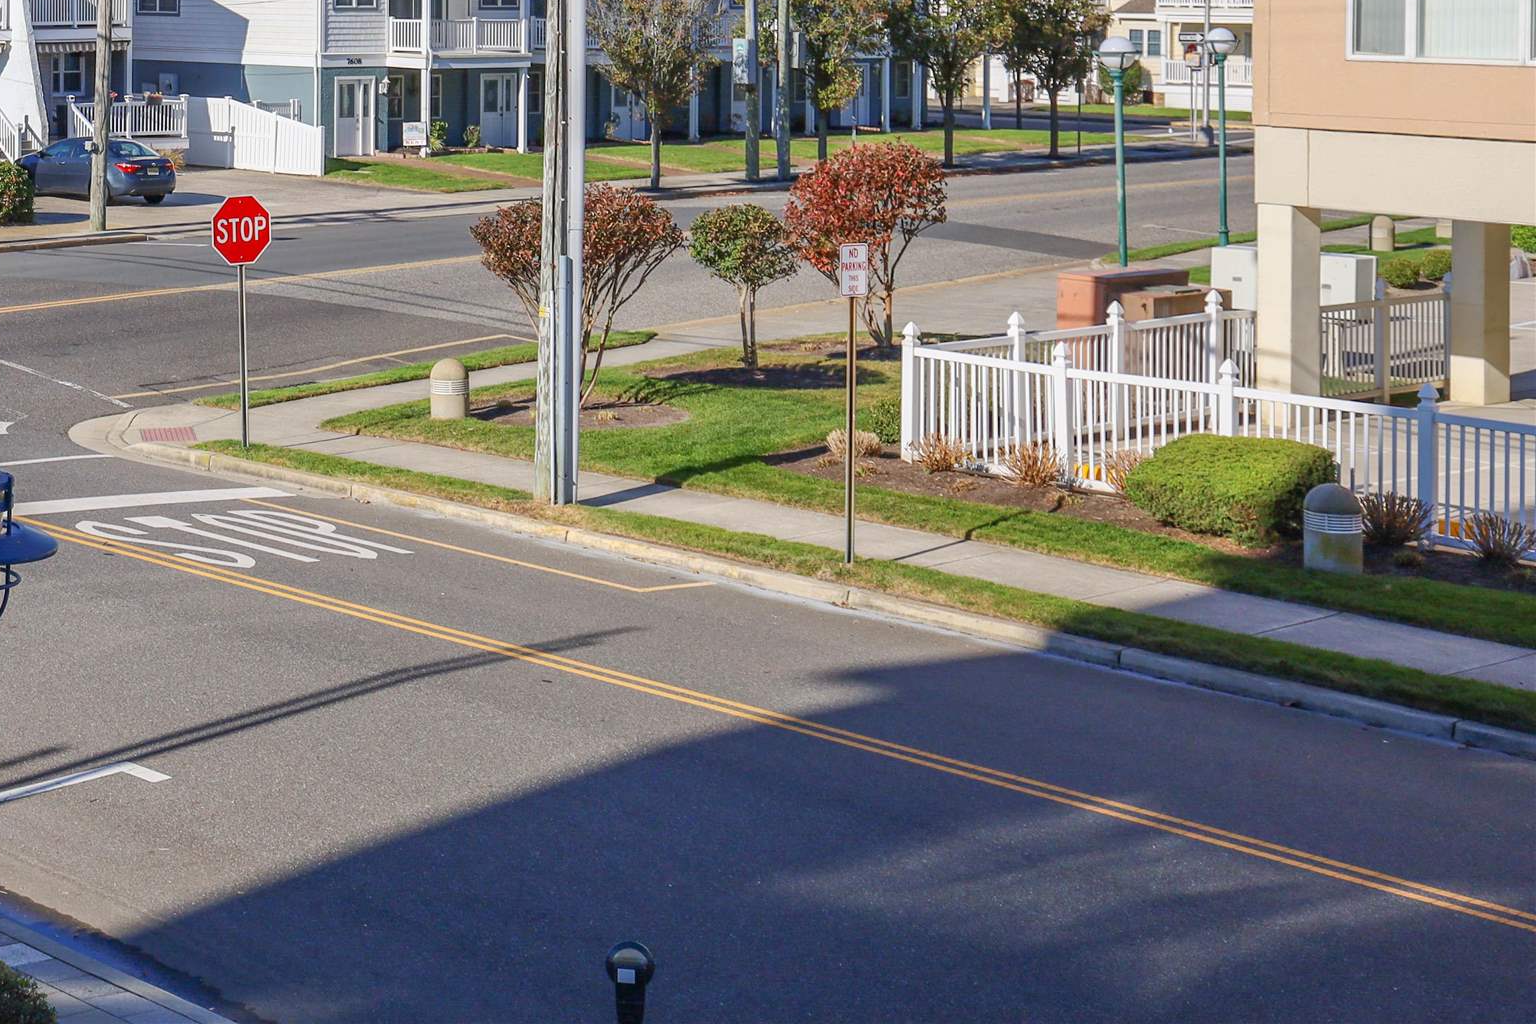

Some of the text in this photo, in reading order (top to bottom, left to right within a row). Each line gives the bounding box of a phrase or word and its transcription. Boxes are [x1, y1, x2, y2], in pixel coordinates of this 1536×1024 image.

[346, 57, 362, 65] 7608
[216, 216, 267, 244] STOP
[848, 248, 859, 259] NO
[841, 262, 867, 272] PARKING
[848, 274, 859, 282] THIS
[75, 509, 415, 569] STOP
